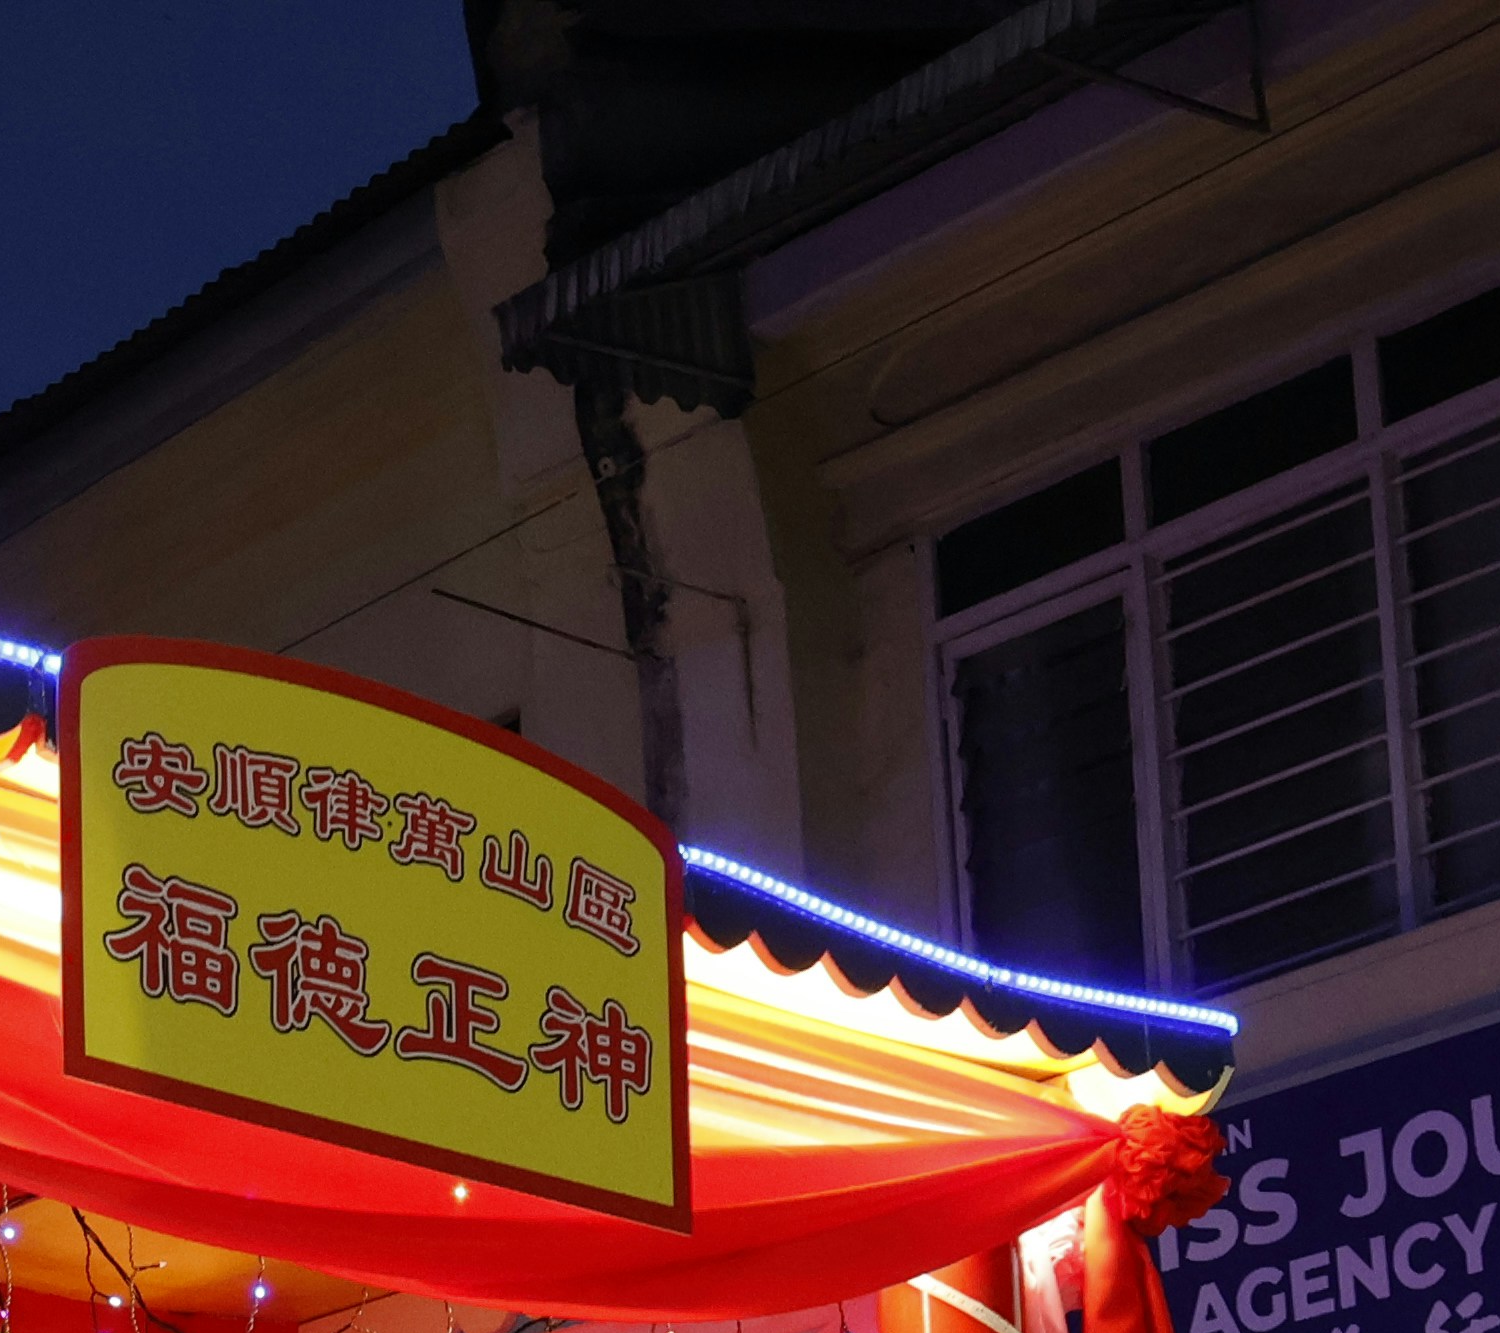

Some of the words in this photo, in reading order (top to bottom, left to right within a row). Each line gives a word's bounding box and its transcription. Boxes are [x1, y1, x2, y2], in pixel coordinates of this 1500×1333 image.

[112, 731, 641, 957] 安順律萬山區
[104, 864, 652, 1122] 福德正神
